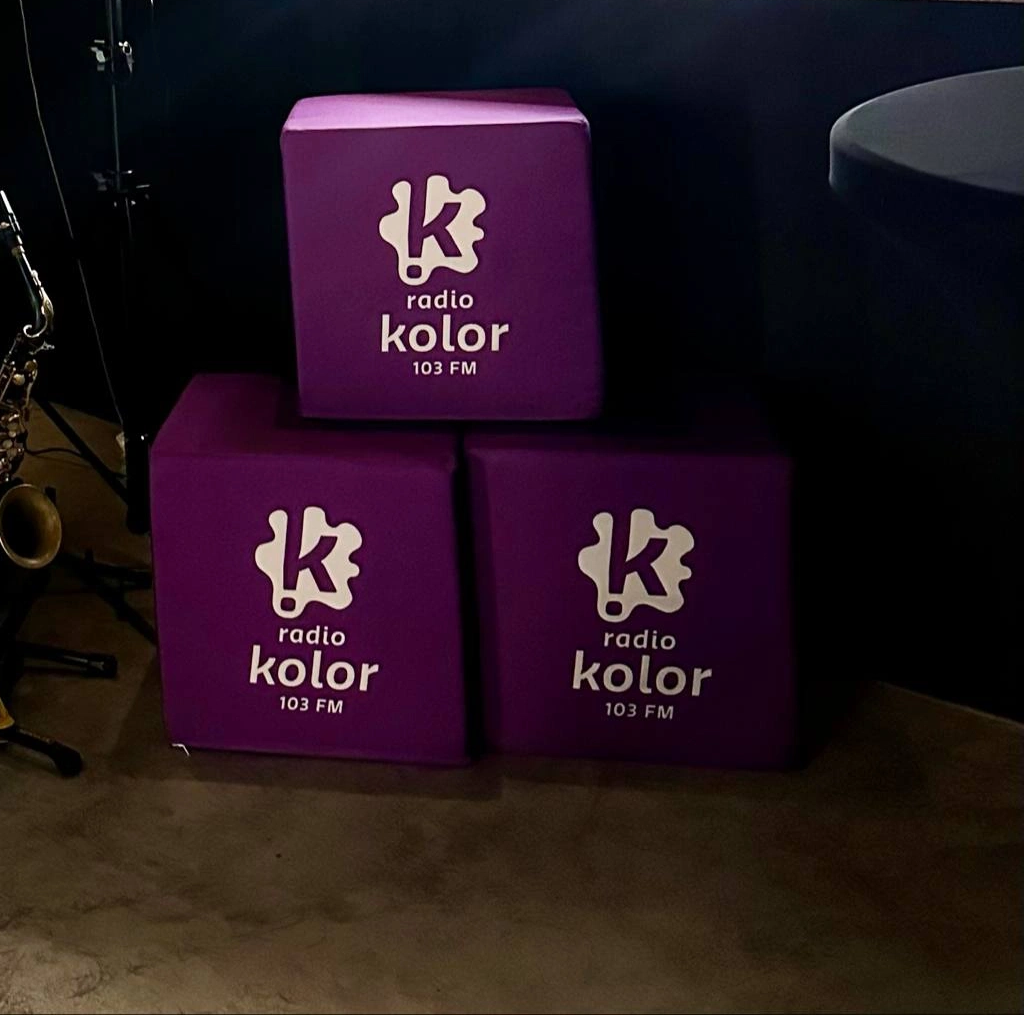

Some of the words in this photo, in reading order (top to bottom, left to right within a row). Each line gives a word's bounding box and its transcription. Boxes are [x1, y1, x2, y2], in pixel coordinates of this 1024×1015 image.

[407, 289, 474, 310] radio
[381, 314, 509, 353] kolor
[412, 361, 443, 375] 103
[450, 361, 477, 375] FM
[278, 625, 346, 646] radio
[603, 629, 676, 650] radio
[249, 644, 379, 692] kolor
[572, 650, 713, 696] kolor
[279, 696, 309, 711] 103
[316, 698, 344, 714] FM
[605, 702, 637, 718] 103
[645, 704, 675, 720] FM
